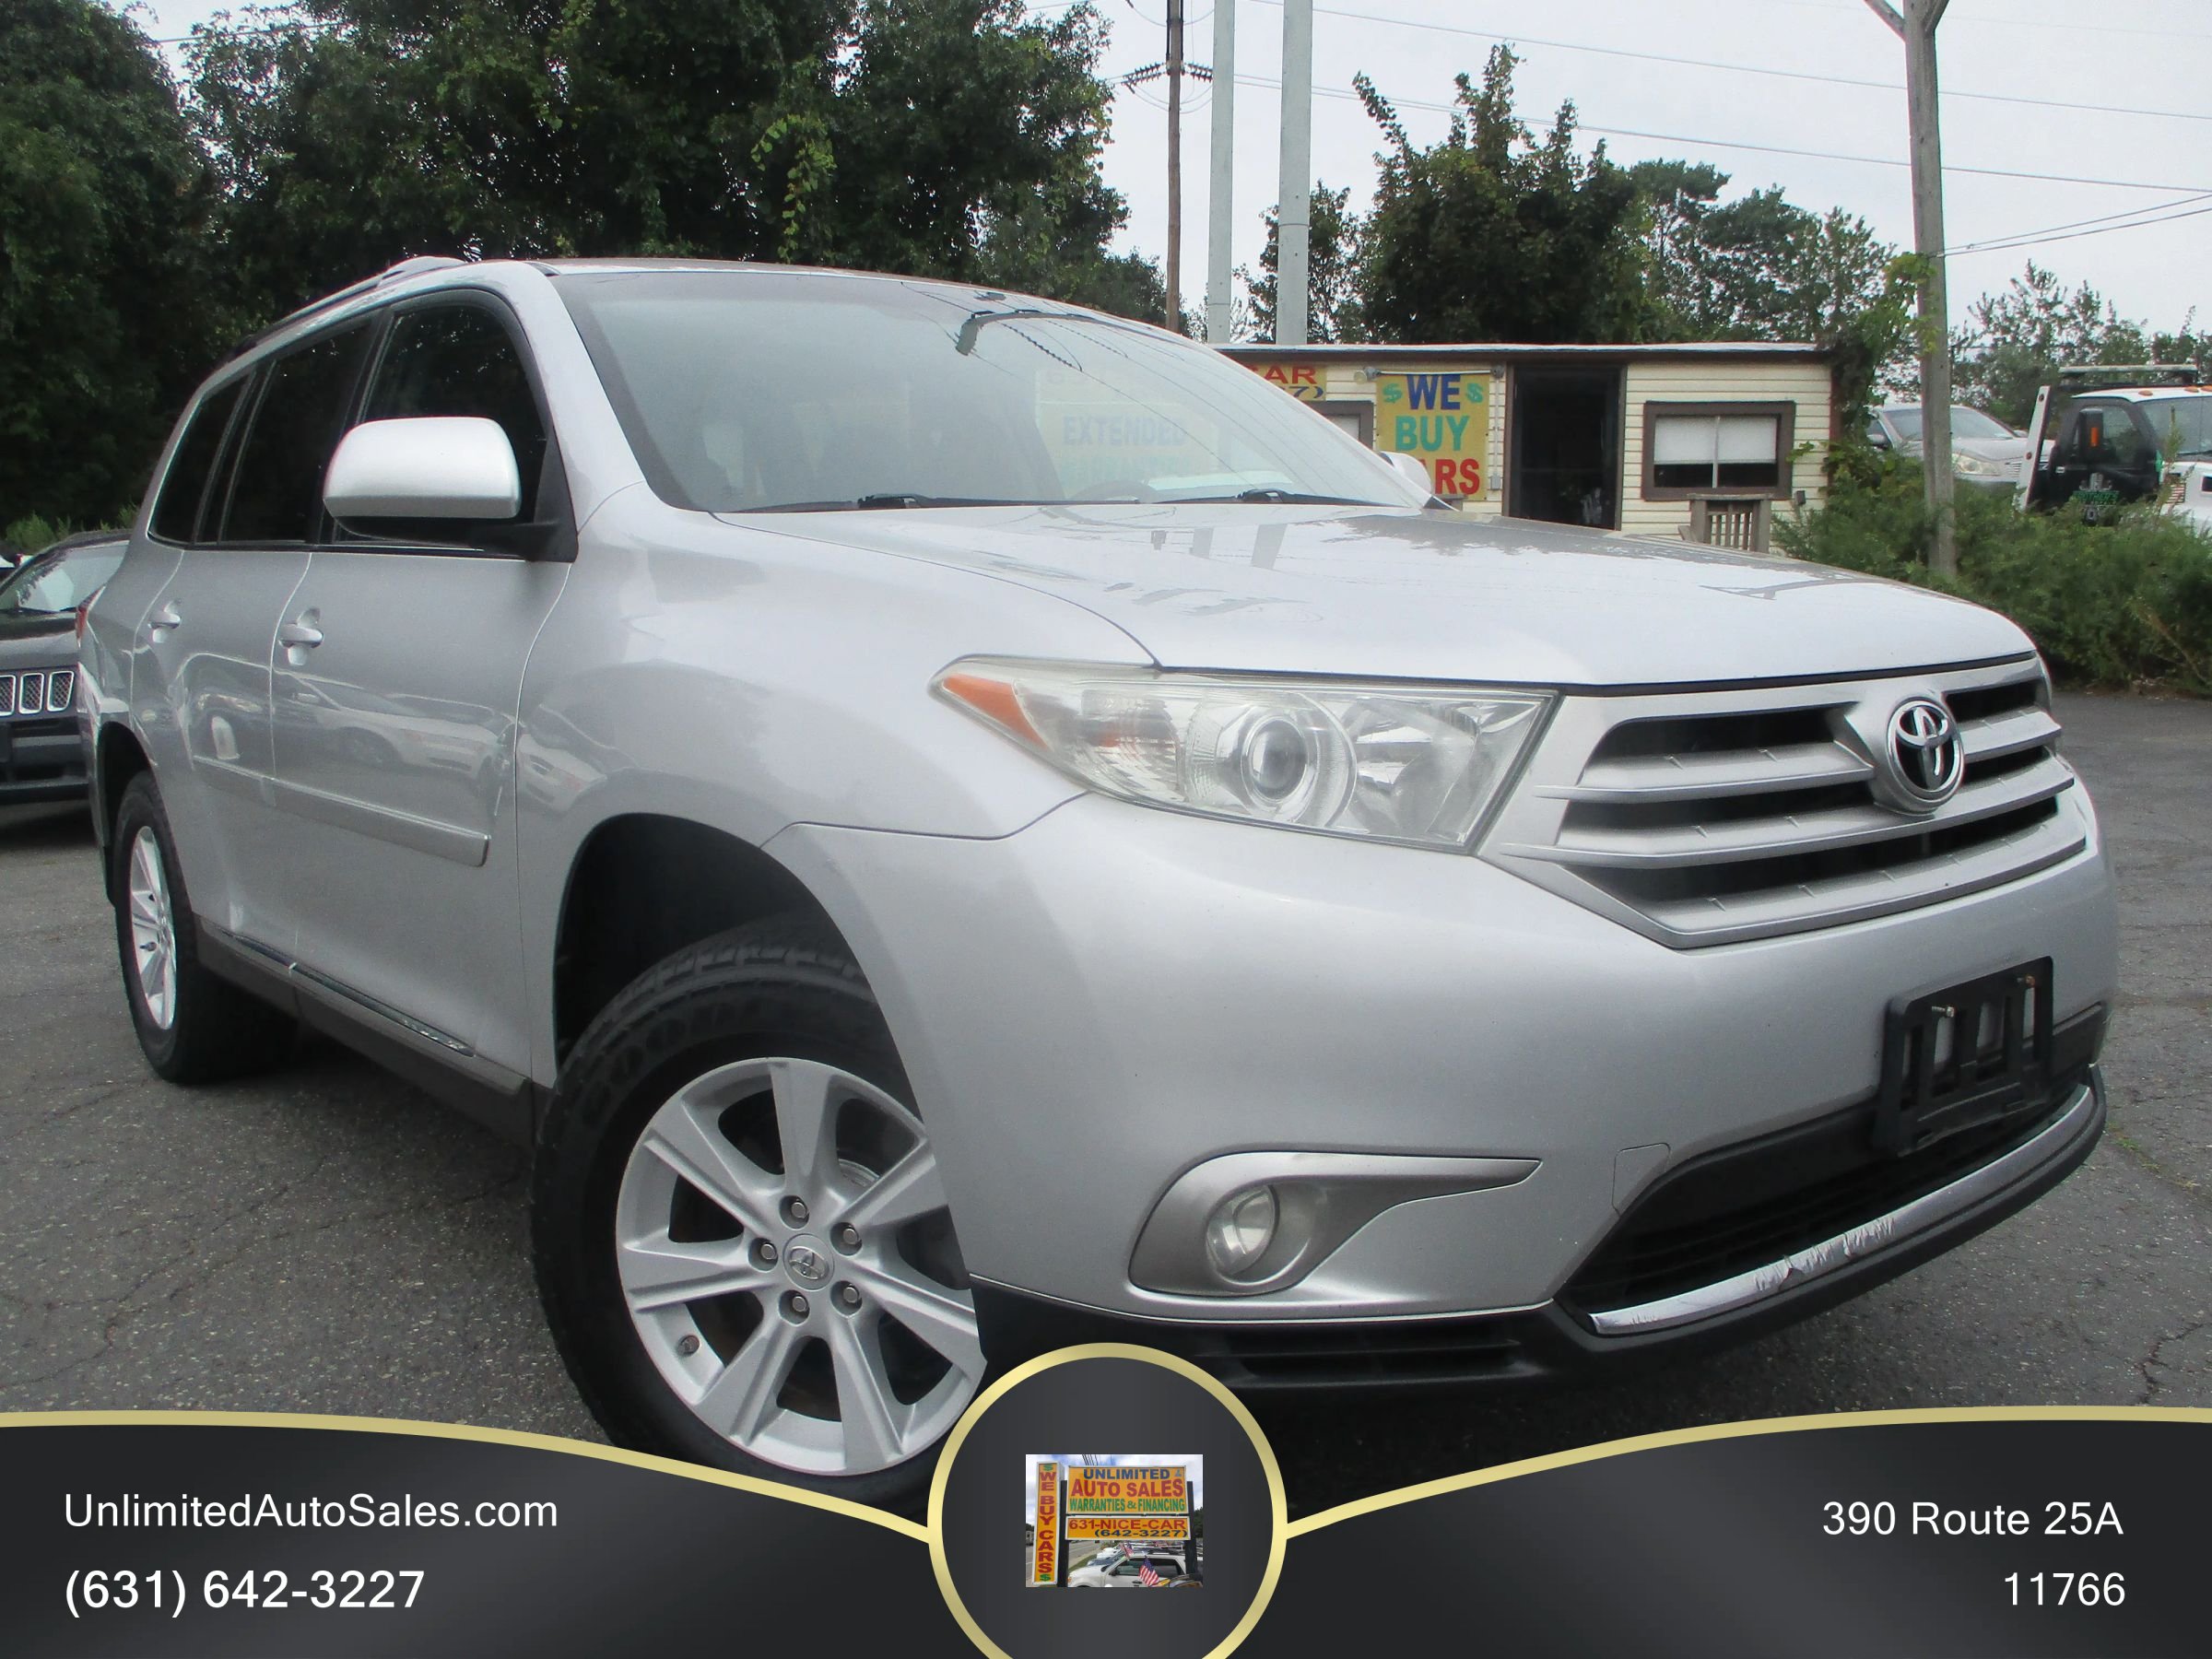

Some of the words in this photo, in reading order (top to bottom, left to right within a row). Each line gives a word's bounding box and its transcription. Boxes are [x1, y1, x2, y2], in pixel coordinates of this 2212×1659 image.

[1245, 365, 1317, 384] AR
[1383, 383, 1403, 404] $
[1406, 373, 1461, 410] WE
[1063, 415, 1187, 445] EXTENDED
[1395, 415, 1470, 452] BUY
[1419, 458, 1480, 496] RS
